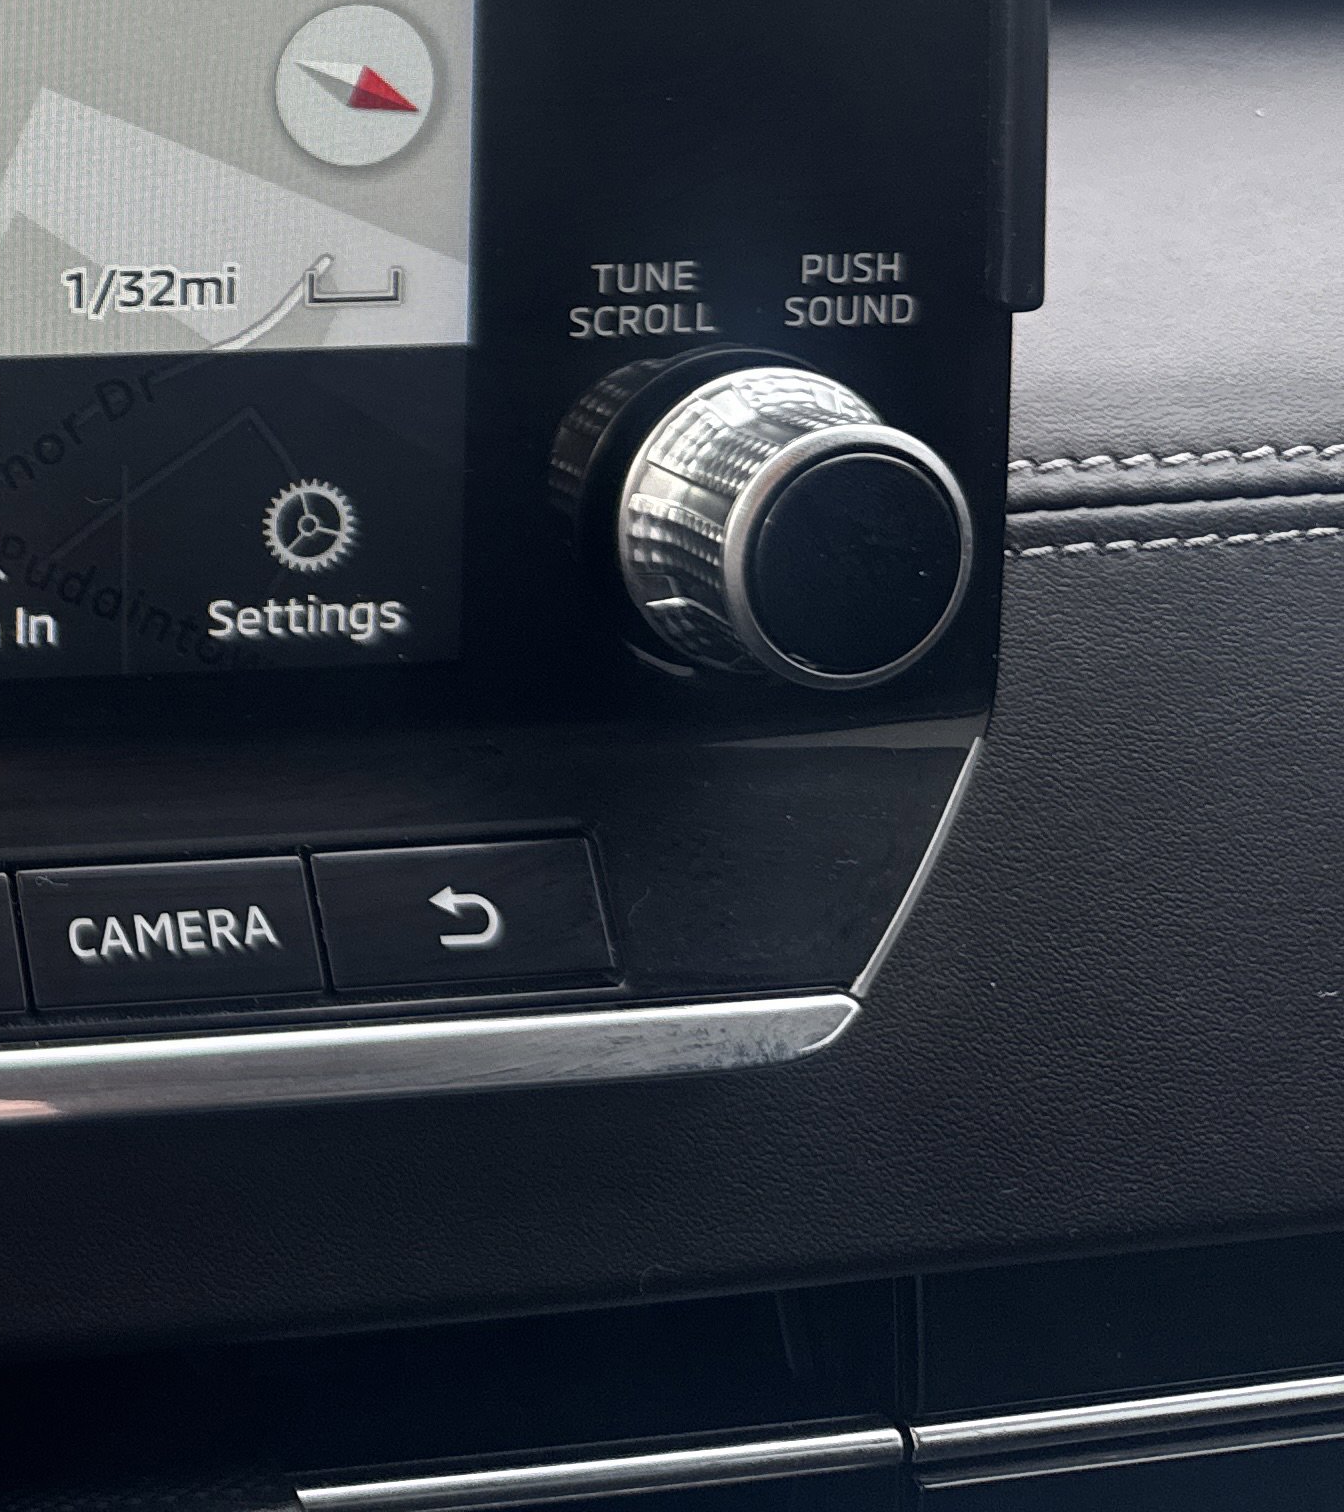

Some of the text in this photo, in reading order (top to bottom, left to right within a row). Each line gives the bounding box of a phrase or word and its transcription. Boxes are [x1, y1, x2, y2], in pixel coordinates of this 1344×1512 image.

[591, 259, 697, 294] TUNE
[801, 251, 902, 285] PUSH
[64, 267, 239, 317] 1/32mi
[784, 293, 915, 328] SOUND
[569, 302, 717, 338] SCROLL
[93, 368, 157, 423] Dr
[15, 605, 58, 646] In
[208, 593, 405, 641] Settings
[67, 904, 279, 960] CAMERA
